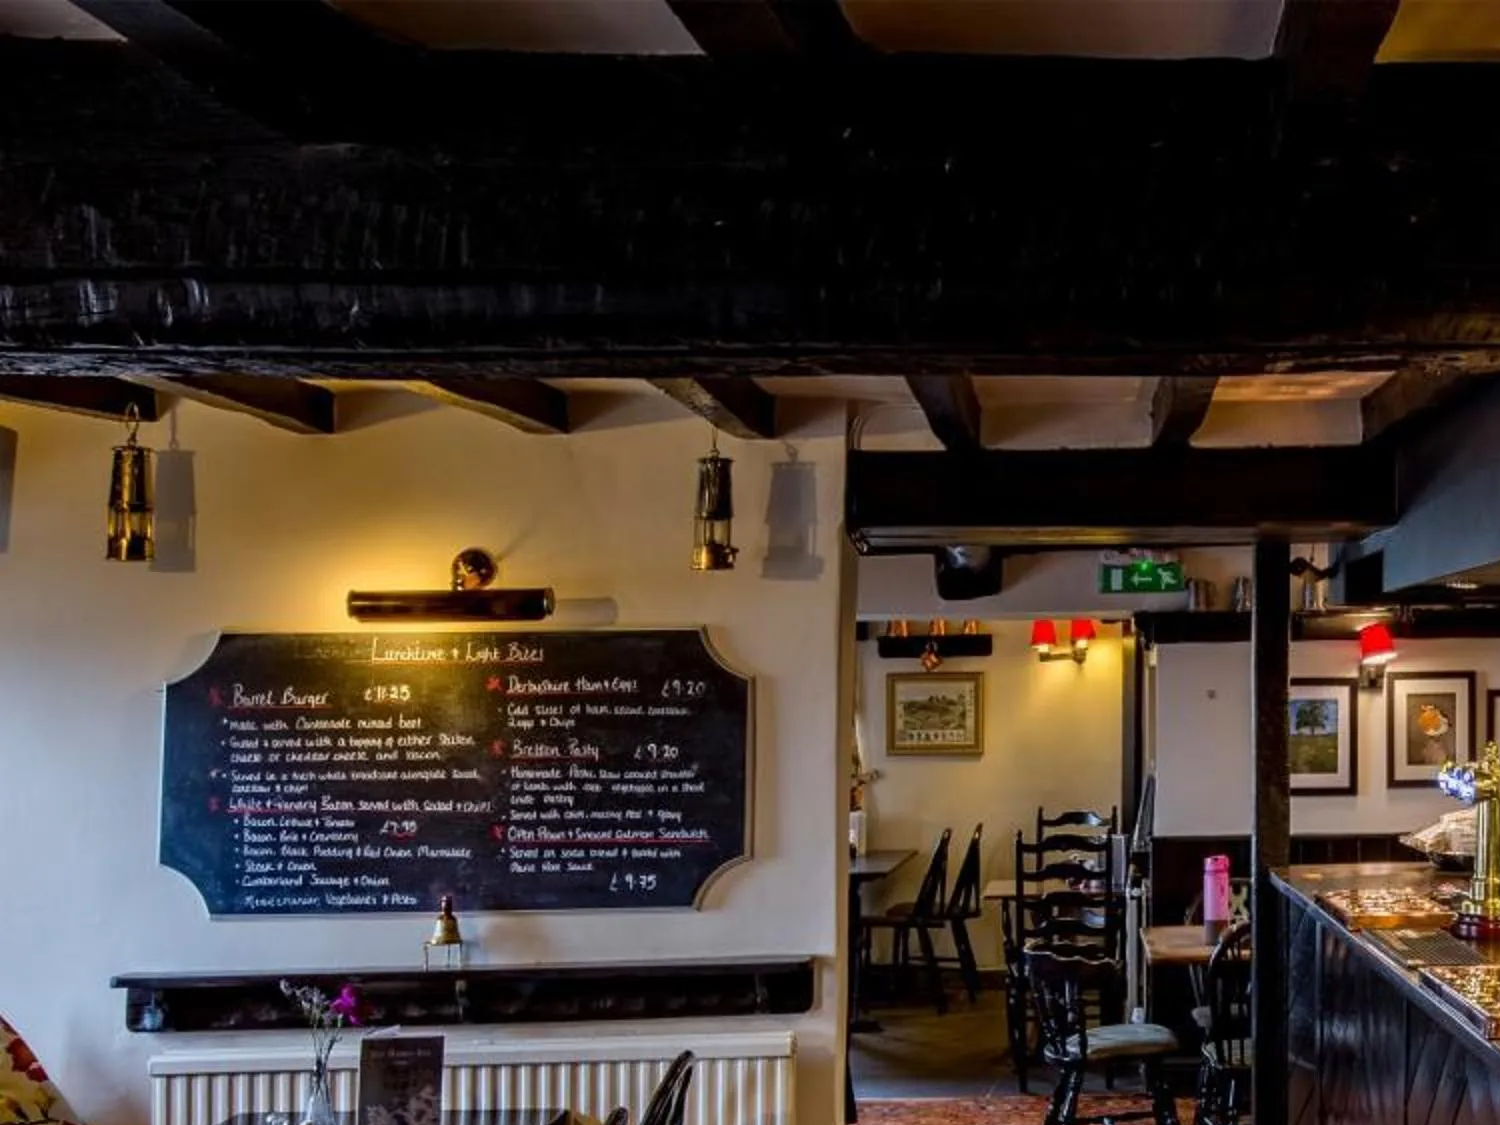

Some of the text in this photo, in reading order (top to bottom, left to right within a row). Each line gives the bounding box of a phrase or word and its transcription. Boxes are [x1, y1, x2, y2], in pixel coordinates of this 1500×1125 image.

[372, 636, 445, 661] Lunchtime
[466, 641, 500, 664] Light
[507, 675, 570, 695] Derbyshire
[575, 675, 603, 691] Ham
[233, 683, 329, 708] Barrel Burger
[263, 718, 288, 730] with
[305, 733, 333, 748] with
[375, 750, 399, 762] and
[391, 799, 419, 811] with
[507, 825, 535, 842] Open
